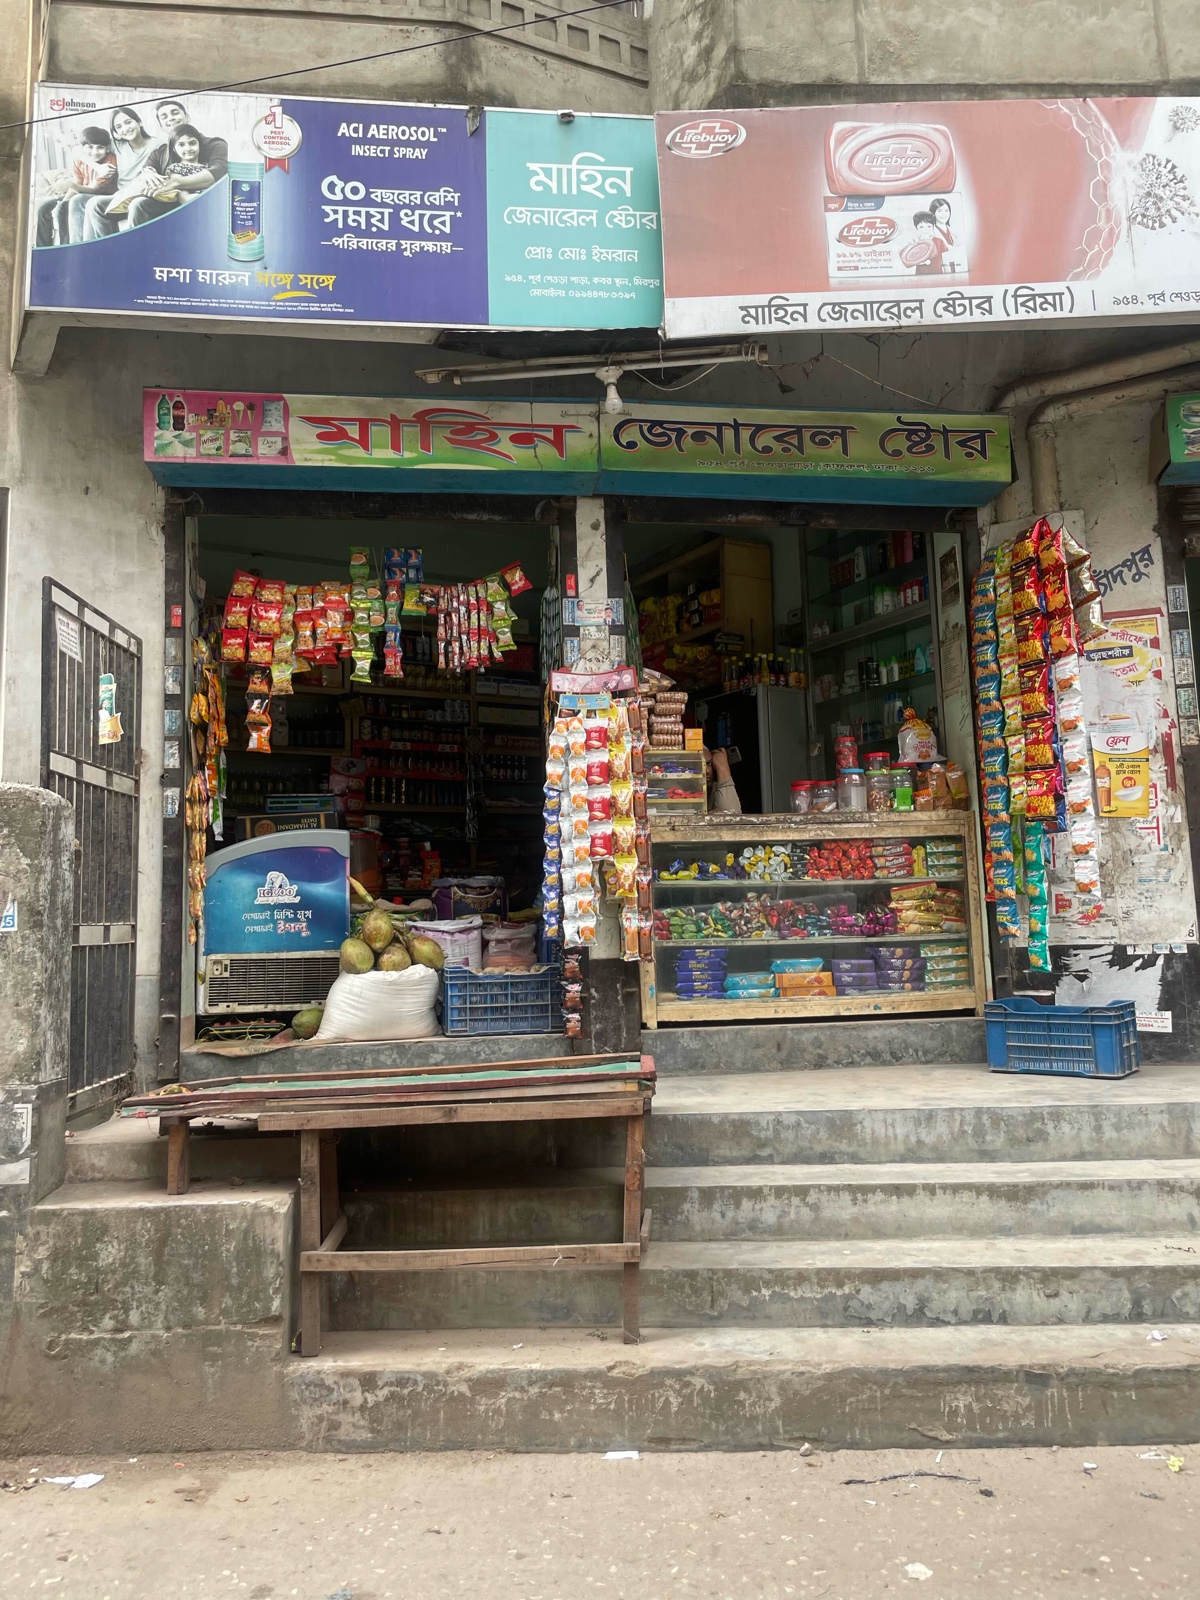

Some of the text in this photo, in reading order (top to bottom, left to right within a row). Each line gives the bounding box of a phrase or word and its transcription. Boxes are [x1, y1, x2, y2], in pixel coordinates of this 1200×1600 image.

[336, 122, 364, 138] ACI
[674, 132, 736, 144] Lifebuoy
[351, 144, 428, 160] INSECT SPRAY
[864, 154, 928, 167] Lifebuoy
[526, 152, 634, 200] মাহিন
[321, 174, 461, 206] ৫০ বছরের বেশি
[321, 205, 393, 232] সময়
[504, 205, 658, 230] জেনারেল ষ্টোর
[842, 226, 894, 237] Lifebuoy
[591, 244, 638, 263] ইমরান
[154, 266, 336, 292] মশা মারুন সঙ্গে সঙ্গে
[528, 274, 542, 286] পূর্ব
[543, 274, 568, 285] শেওড়া
[592, 276, 612, 285] কবর
[633, 276, 660, 288] মিরপুর
[739, 295, 808, 326] মাহিন
[816, 300, 925, 324] জেনারেল
[932, 290, 993, 318] ষ্টোর
[1002, 285, 1076, 317] (রিমা)
[1147, 290, 1166, 306] পূর্ব
[295, 406, 998, 464] মাহিন জেনারেল ষ্টোর
[1092, 544, 1155, 598] চাঁদপুর
[278, 823, 308, 831] HAMDANI
[258, 888, 295, 897] IGLOO
